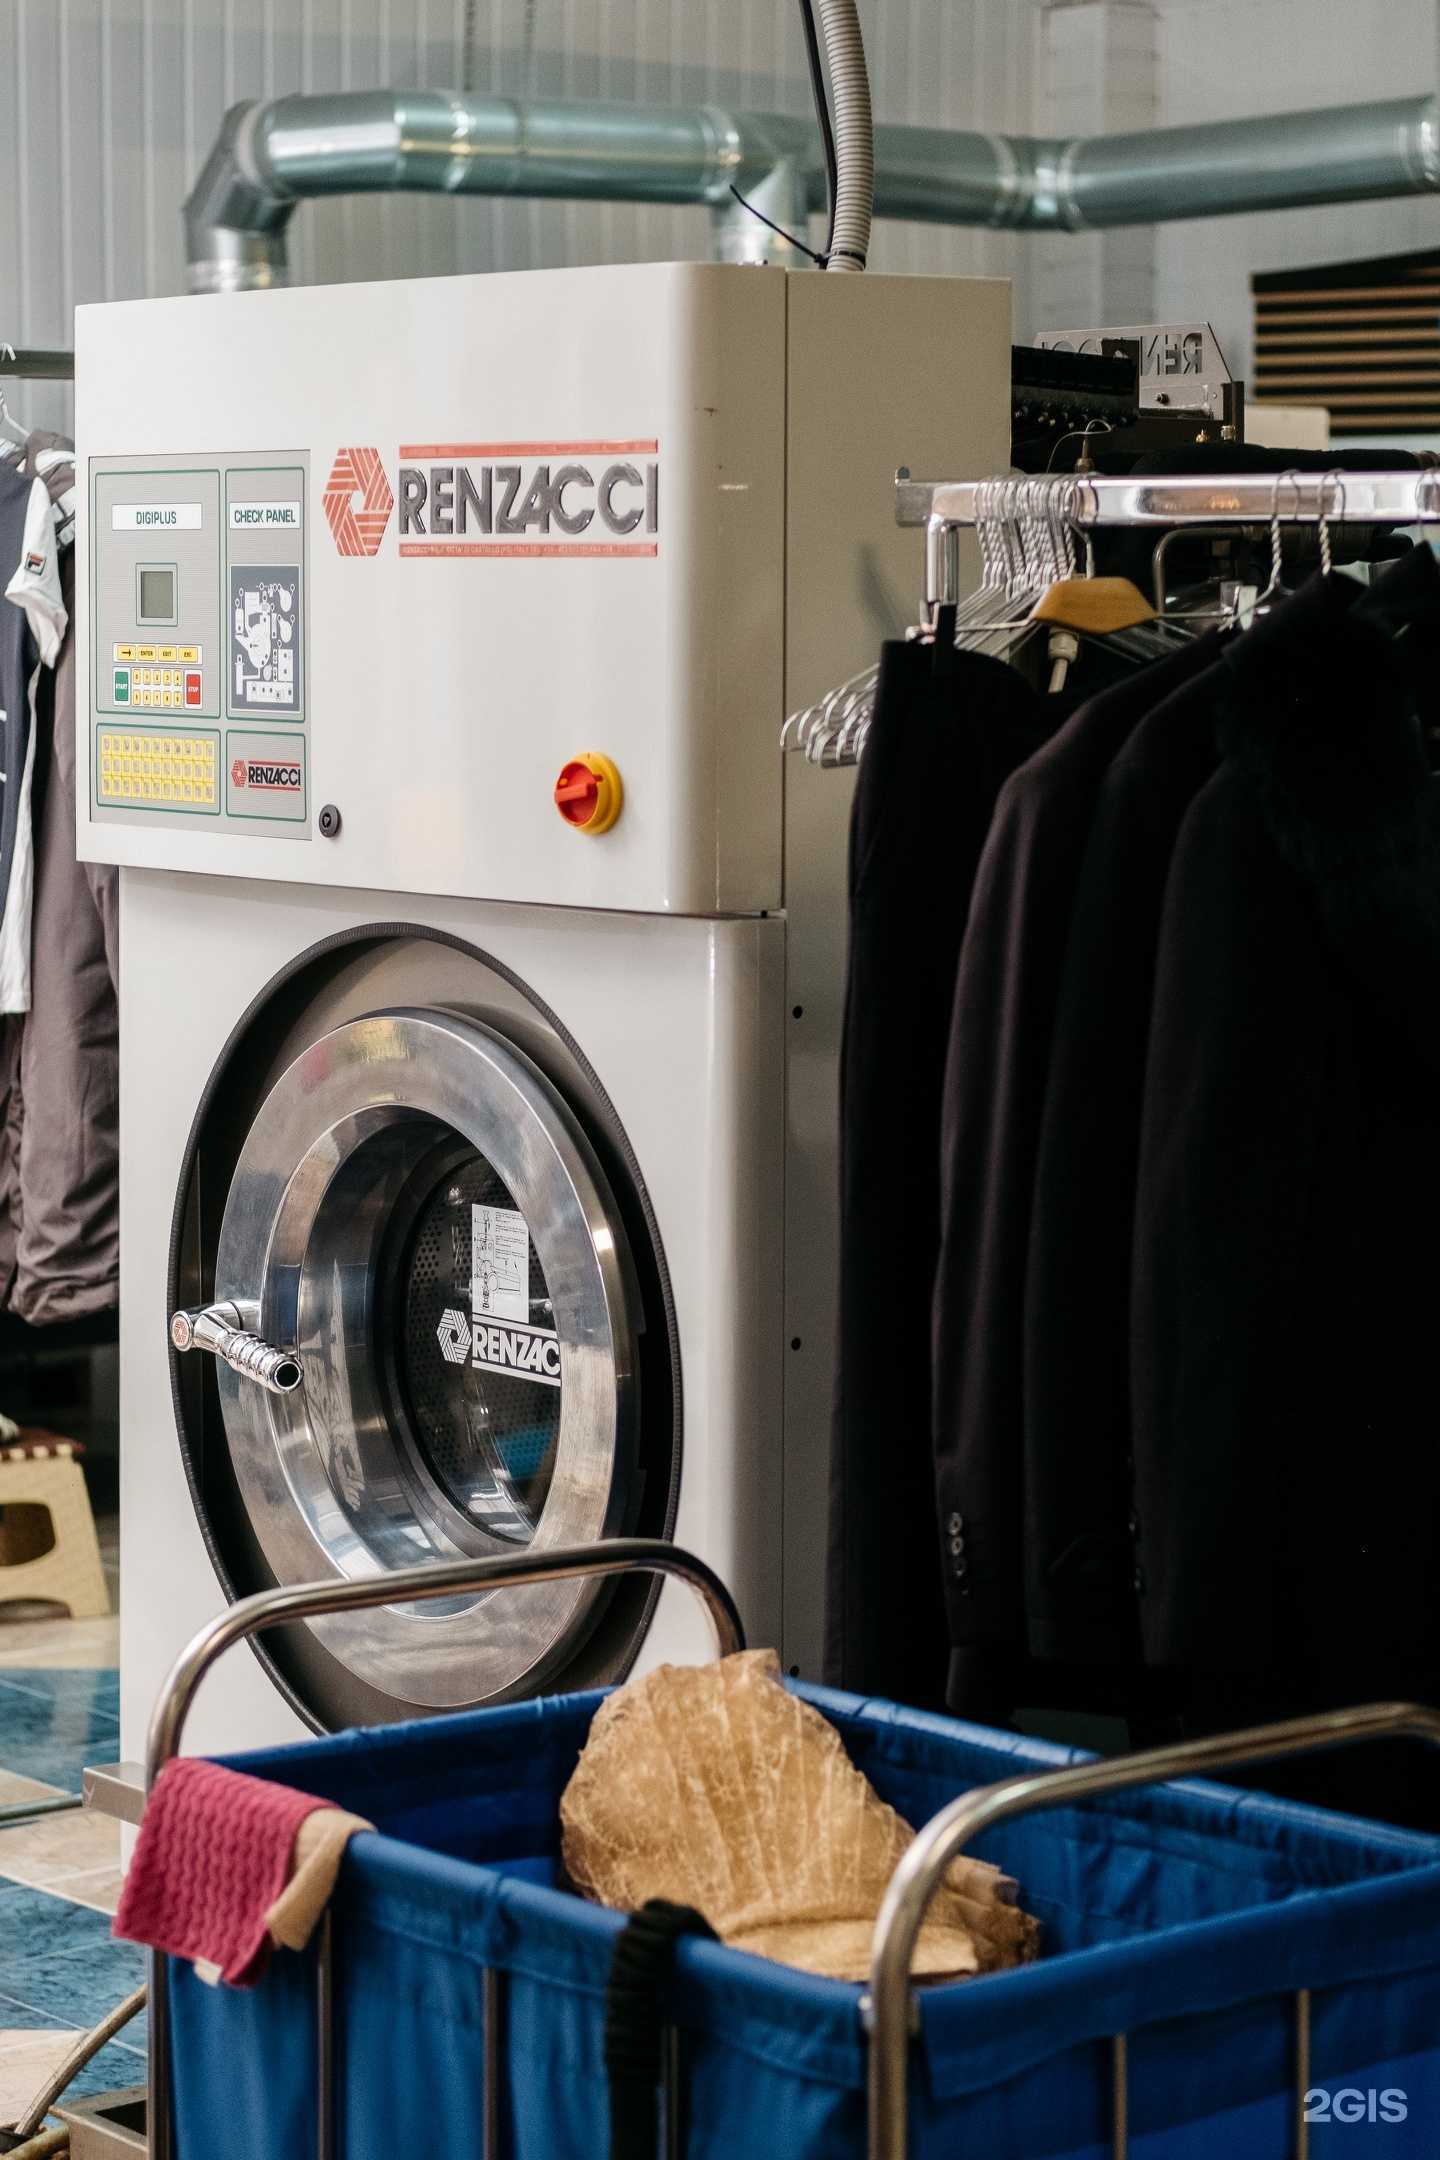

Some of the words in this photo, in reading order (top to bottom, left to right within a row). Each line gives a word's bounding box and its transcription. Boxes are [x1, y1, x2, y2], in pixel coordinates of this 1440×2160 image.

[398, 463, 658, 535] RENZACCI
[136, 511, 177, 525] DIGIPLUS
[234, 510, 264, 524] CHECK
[266, 509, 296, 523] PANEL
[248, 766, 301, 786] RENZACCI
